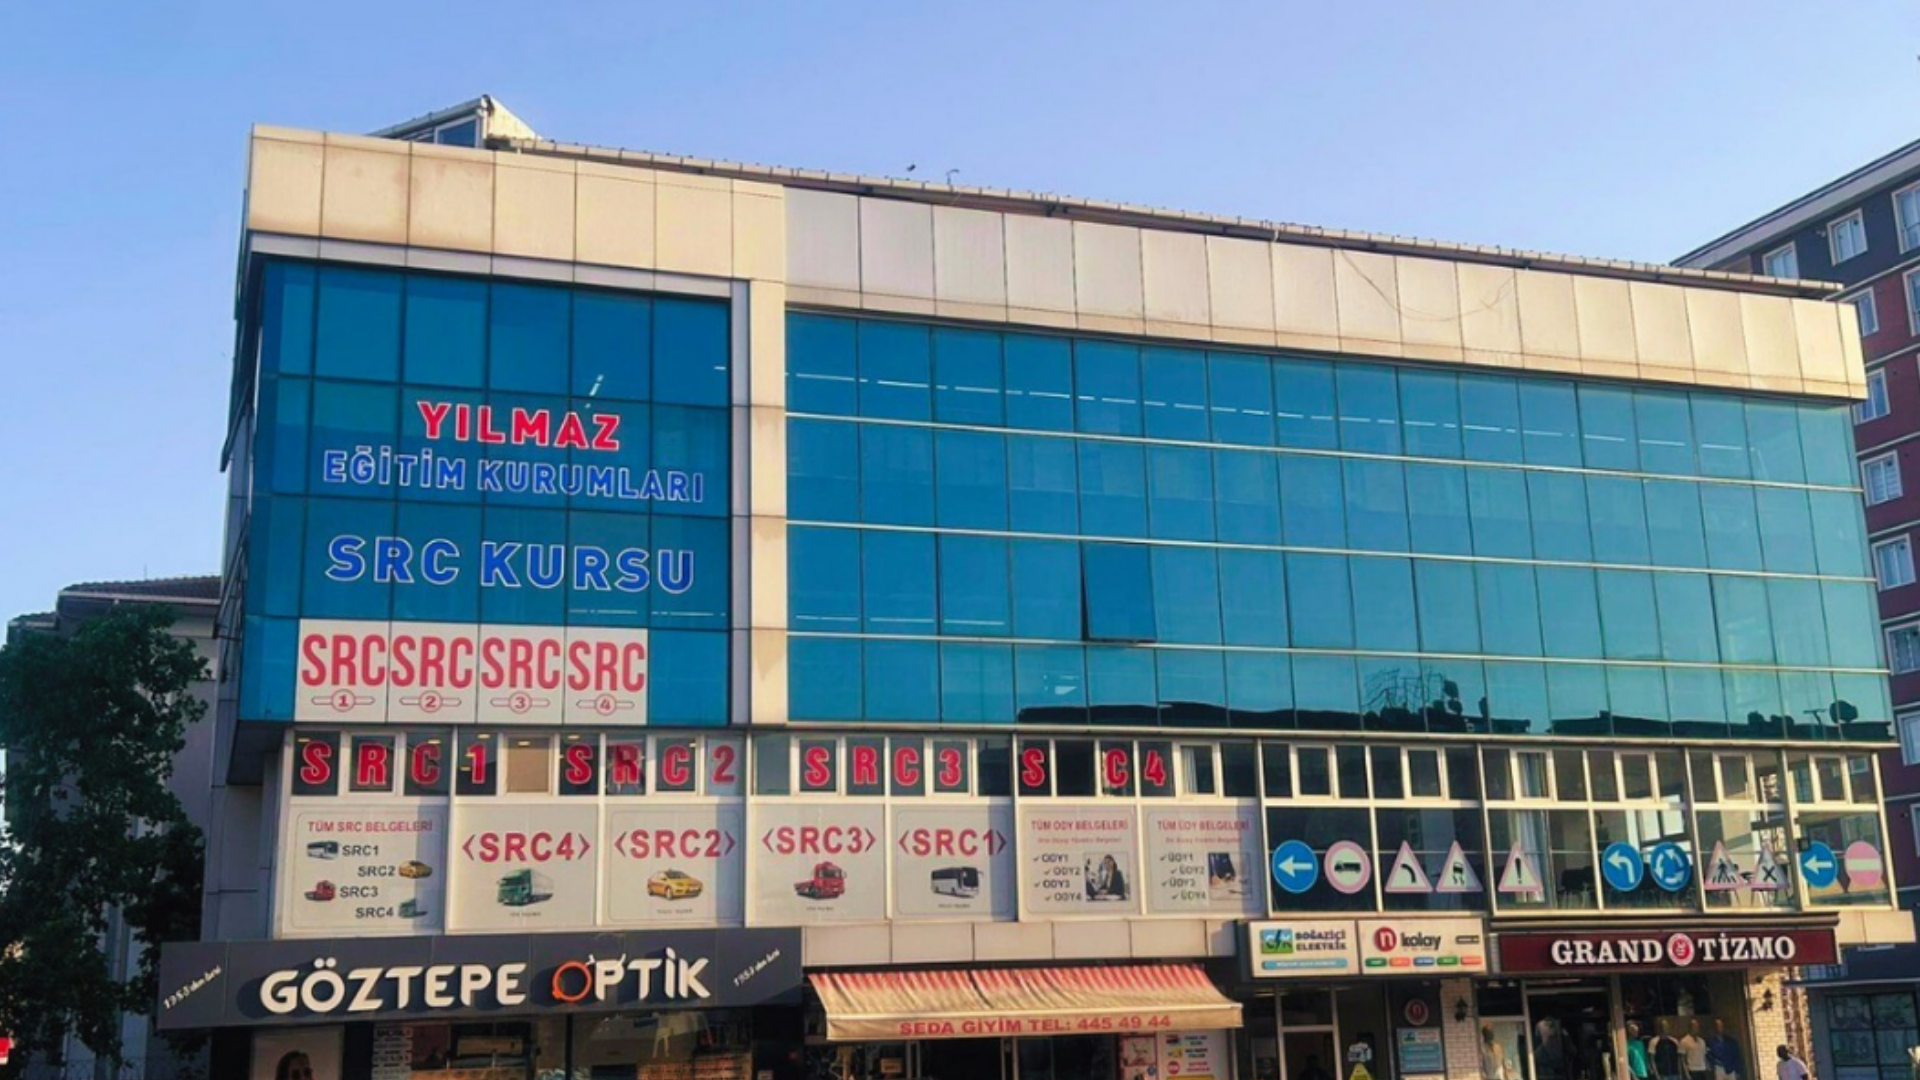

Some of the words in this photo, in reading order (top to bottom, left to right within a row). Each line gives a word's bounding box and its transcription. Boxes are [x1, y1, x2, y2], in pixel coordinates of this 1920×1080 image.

[418, 401, 621, 452] YILMAZ
[323, 445, 467, 491] EĞİTİM
[477, 459, 704, 503] KURUMLARI
[325, 534, 461, 584] SRC
[480, 541, 695, 594] KURSU
[302, 633, 387, 687] SRC
[391, 635, 474, 689] SRC
[481, 636, 562, 690] SRC
[567, 640, 646, 693] SRC
[338, 694, 350, 708] 1
[424, 694, 437, 709] 2
[514, 695, 527, 710] 3
[599, 698, 612, 712] 4
[308, 820, 334, 832] TÜM
[337, 821, 363, 832] SRC
[365, 820, 433, 832] BELGELERİ
[775, 825, 863, 856] SRC3
[342, 845, 379, 857] SRC1
[478, 832, 576, 863] SRC4
[629, 829, 722, 860] SRC2
[914, 828, 997, 857] SRC1
[357, 865, 396, 877] SRC2
[340, 885, 378, 898] SRC3
[355, 907, 394, 919] SRC4
[1400, 930, 1441, 951] kolay
[1551, 938, 1663, 964] GRAND
[1697, 932, 1796, 962] TİZMO
[260, 957, 527, 1014] GÖZTEPE
[552, 946, 711, 1003] OPTİK
[901, 1020, 955, 1037] SEDA
[961, 1017, 1021, 1034] GİYİM
[1027, 1017, 1071, 1032] TEL:
[1077, 1016, 1112, 1030] 445
[1118, 1015, 1142, 1029] 49
[1148, 1015, 1171, 1028] 44
